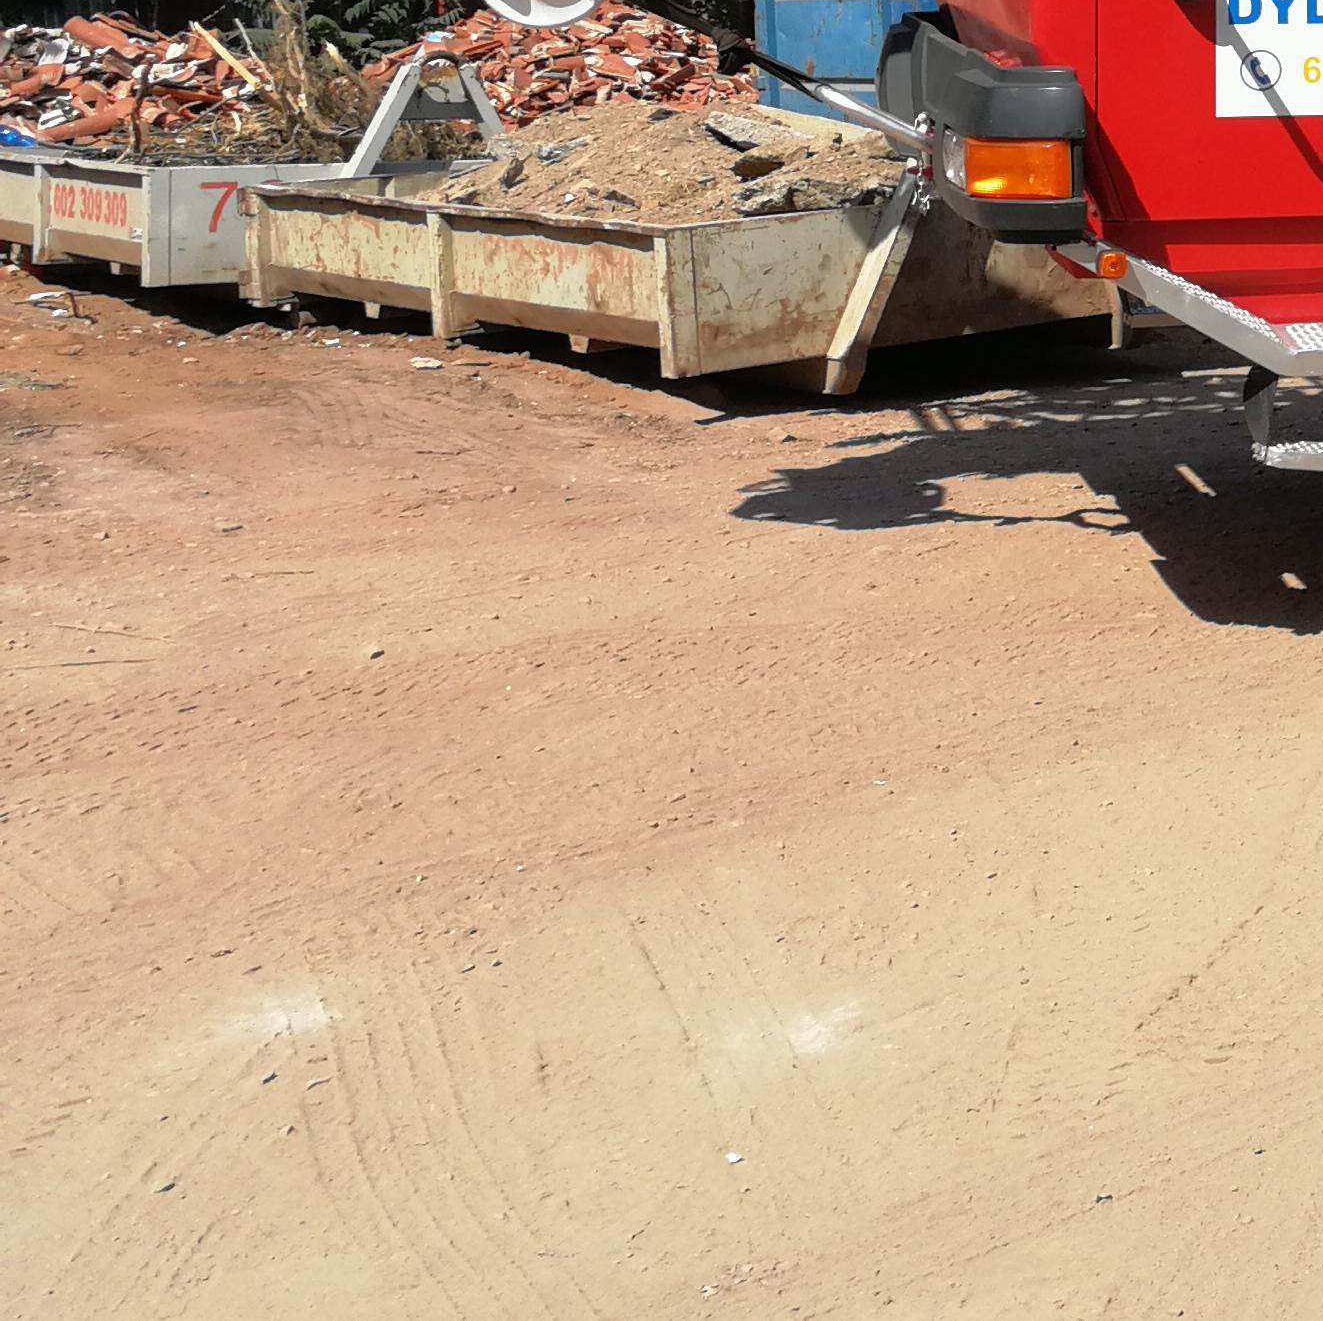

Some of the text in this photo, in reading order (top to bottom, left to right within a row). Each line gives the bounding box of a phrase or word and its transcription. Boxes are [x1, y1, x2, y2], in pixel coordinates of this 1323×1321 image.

[54, 183, 128, 227] 602 309 309
[199, 182, 238, 232] 7
